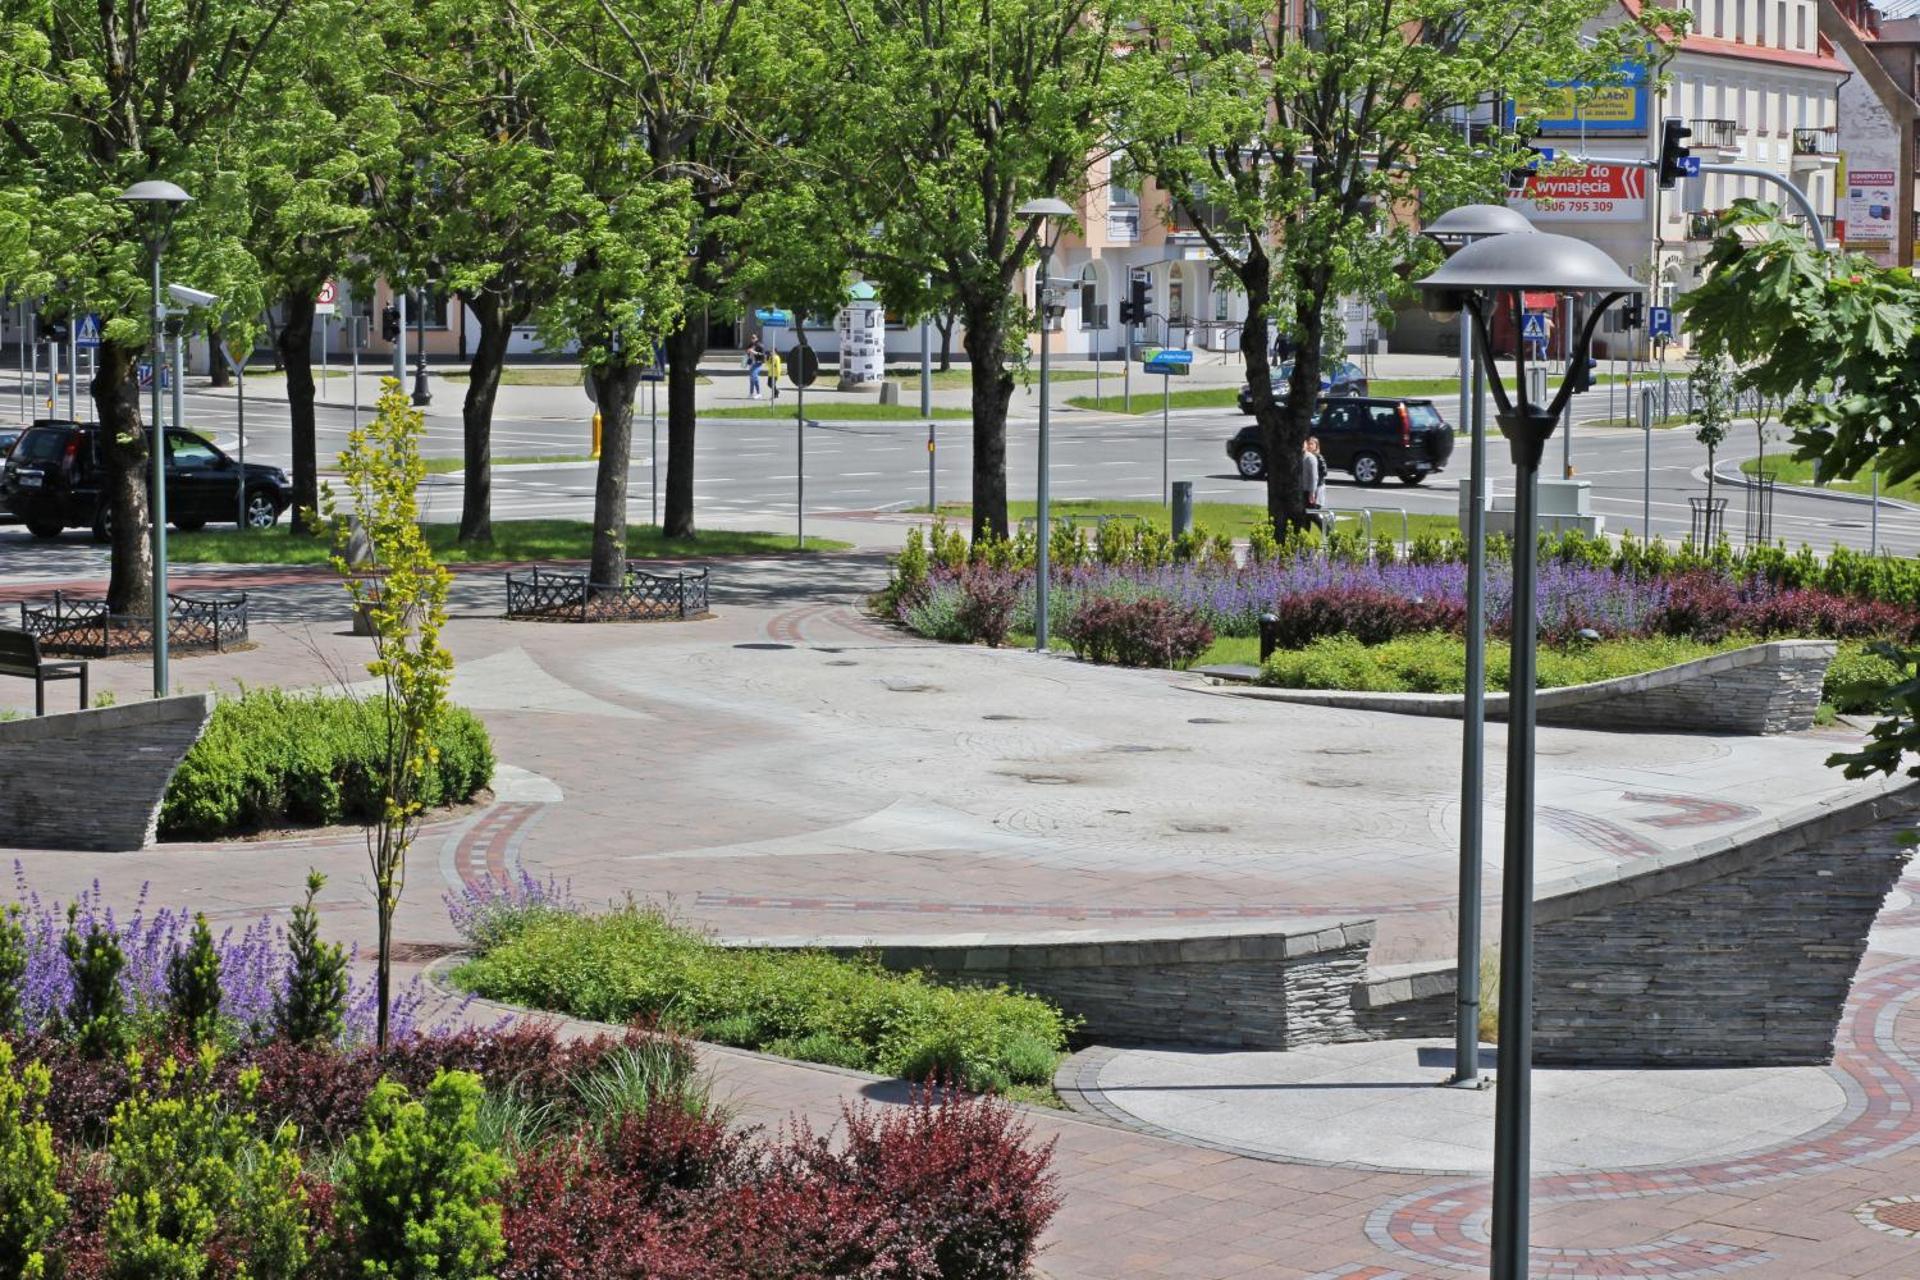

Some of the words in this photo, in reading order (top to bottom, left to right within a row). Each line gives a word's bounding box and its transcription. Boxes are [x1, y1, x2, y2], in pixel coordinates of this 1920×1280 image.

[1590, 165, 1610, 177] do
[1536, 179, 1611, 196] wynajęcia
[1544, 201, 1565, 212] 506
[1568, 201, 1590, 212] 795
[1592, 201, 1614, 212] 309
[1654, 309, 1668, 329] P
